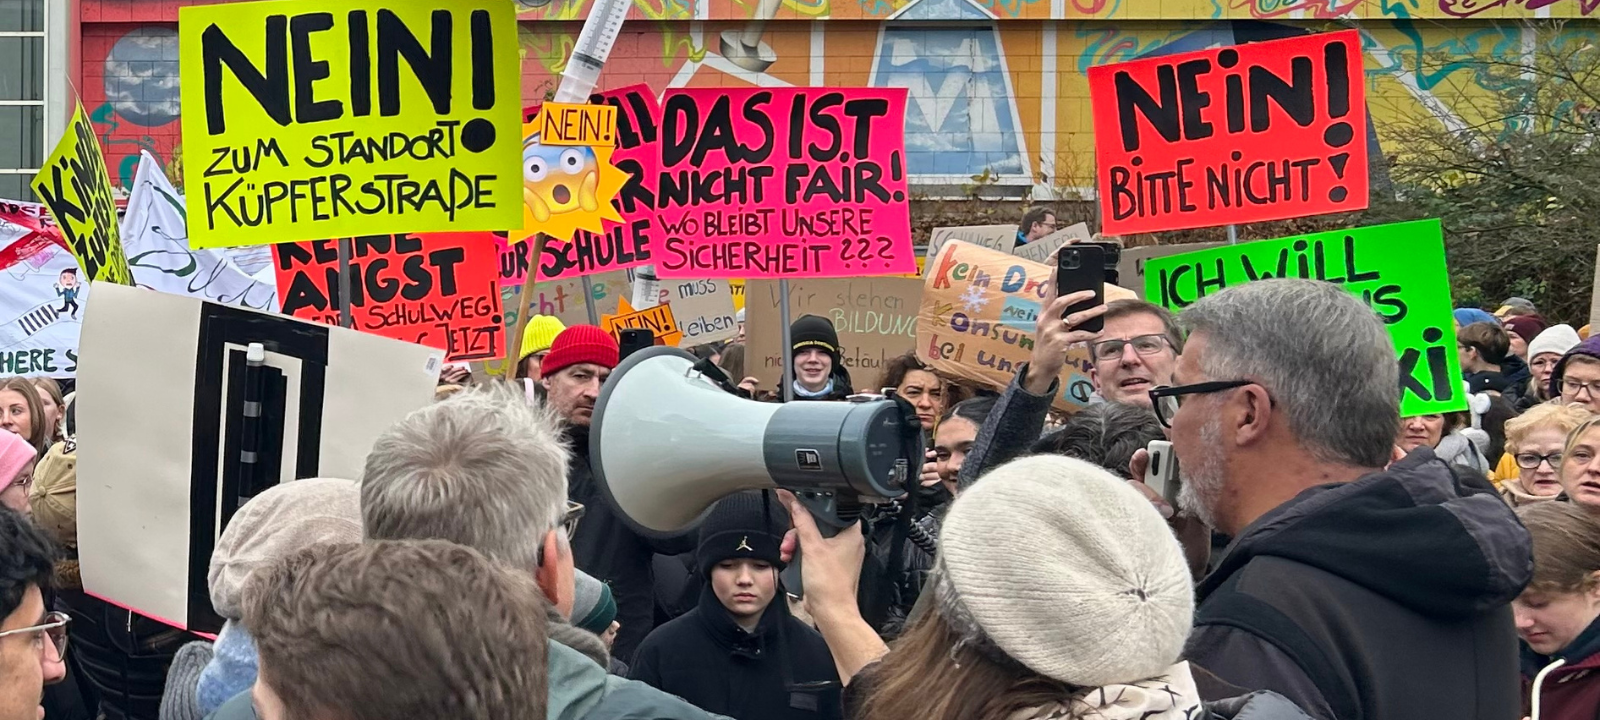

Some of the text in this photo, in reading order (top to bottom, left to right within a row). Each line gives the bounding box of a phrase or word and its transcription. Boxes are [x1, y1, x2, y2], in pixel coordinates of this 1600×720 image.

[202, 8, 496, 153] NEIN!
[543, 108, 612, 142] NEIN!
[662, 92, 774, 168] DAS
[788, 92, 888, 162] IST
[203, 120, 460, 177] ZUM STANDORT
[657, 164, 774, 209] NICHT
[658, 210, 699, 237] WO
[541, 219, 651, 278] SCHULE
[840, 236, 895, 269] ???
[281, 247, 464, 315] ANGST
[678, 278, 717, 299] muss
[769, 283, 817, 308] Wir
[836, 282, 904, 309] stehen
[1160, 257, 1227, 309] ICH
[365, 280, 502, 328] SCHULWEG!
[435, 322, 501, 360] JETZT
[680, 314, 734, 338] leiben
[765, 353, 783, 368] nic
[928, 334, 965, 361] bei
